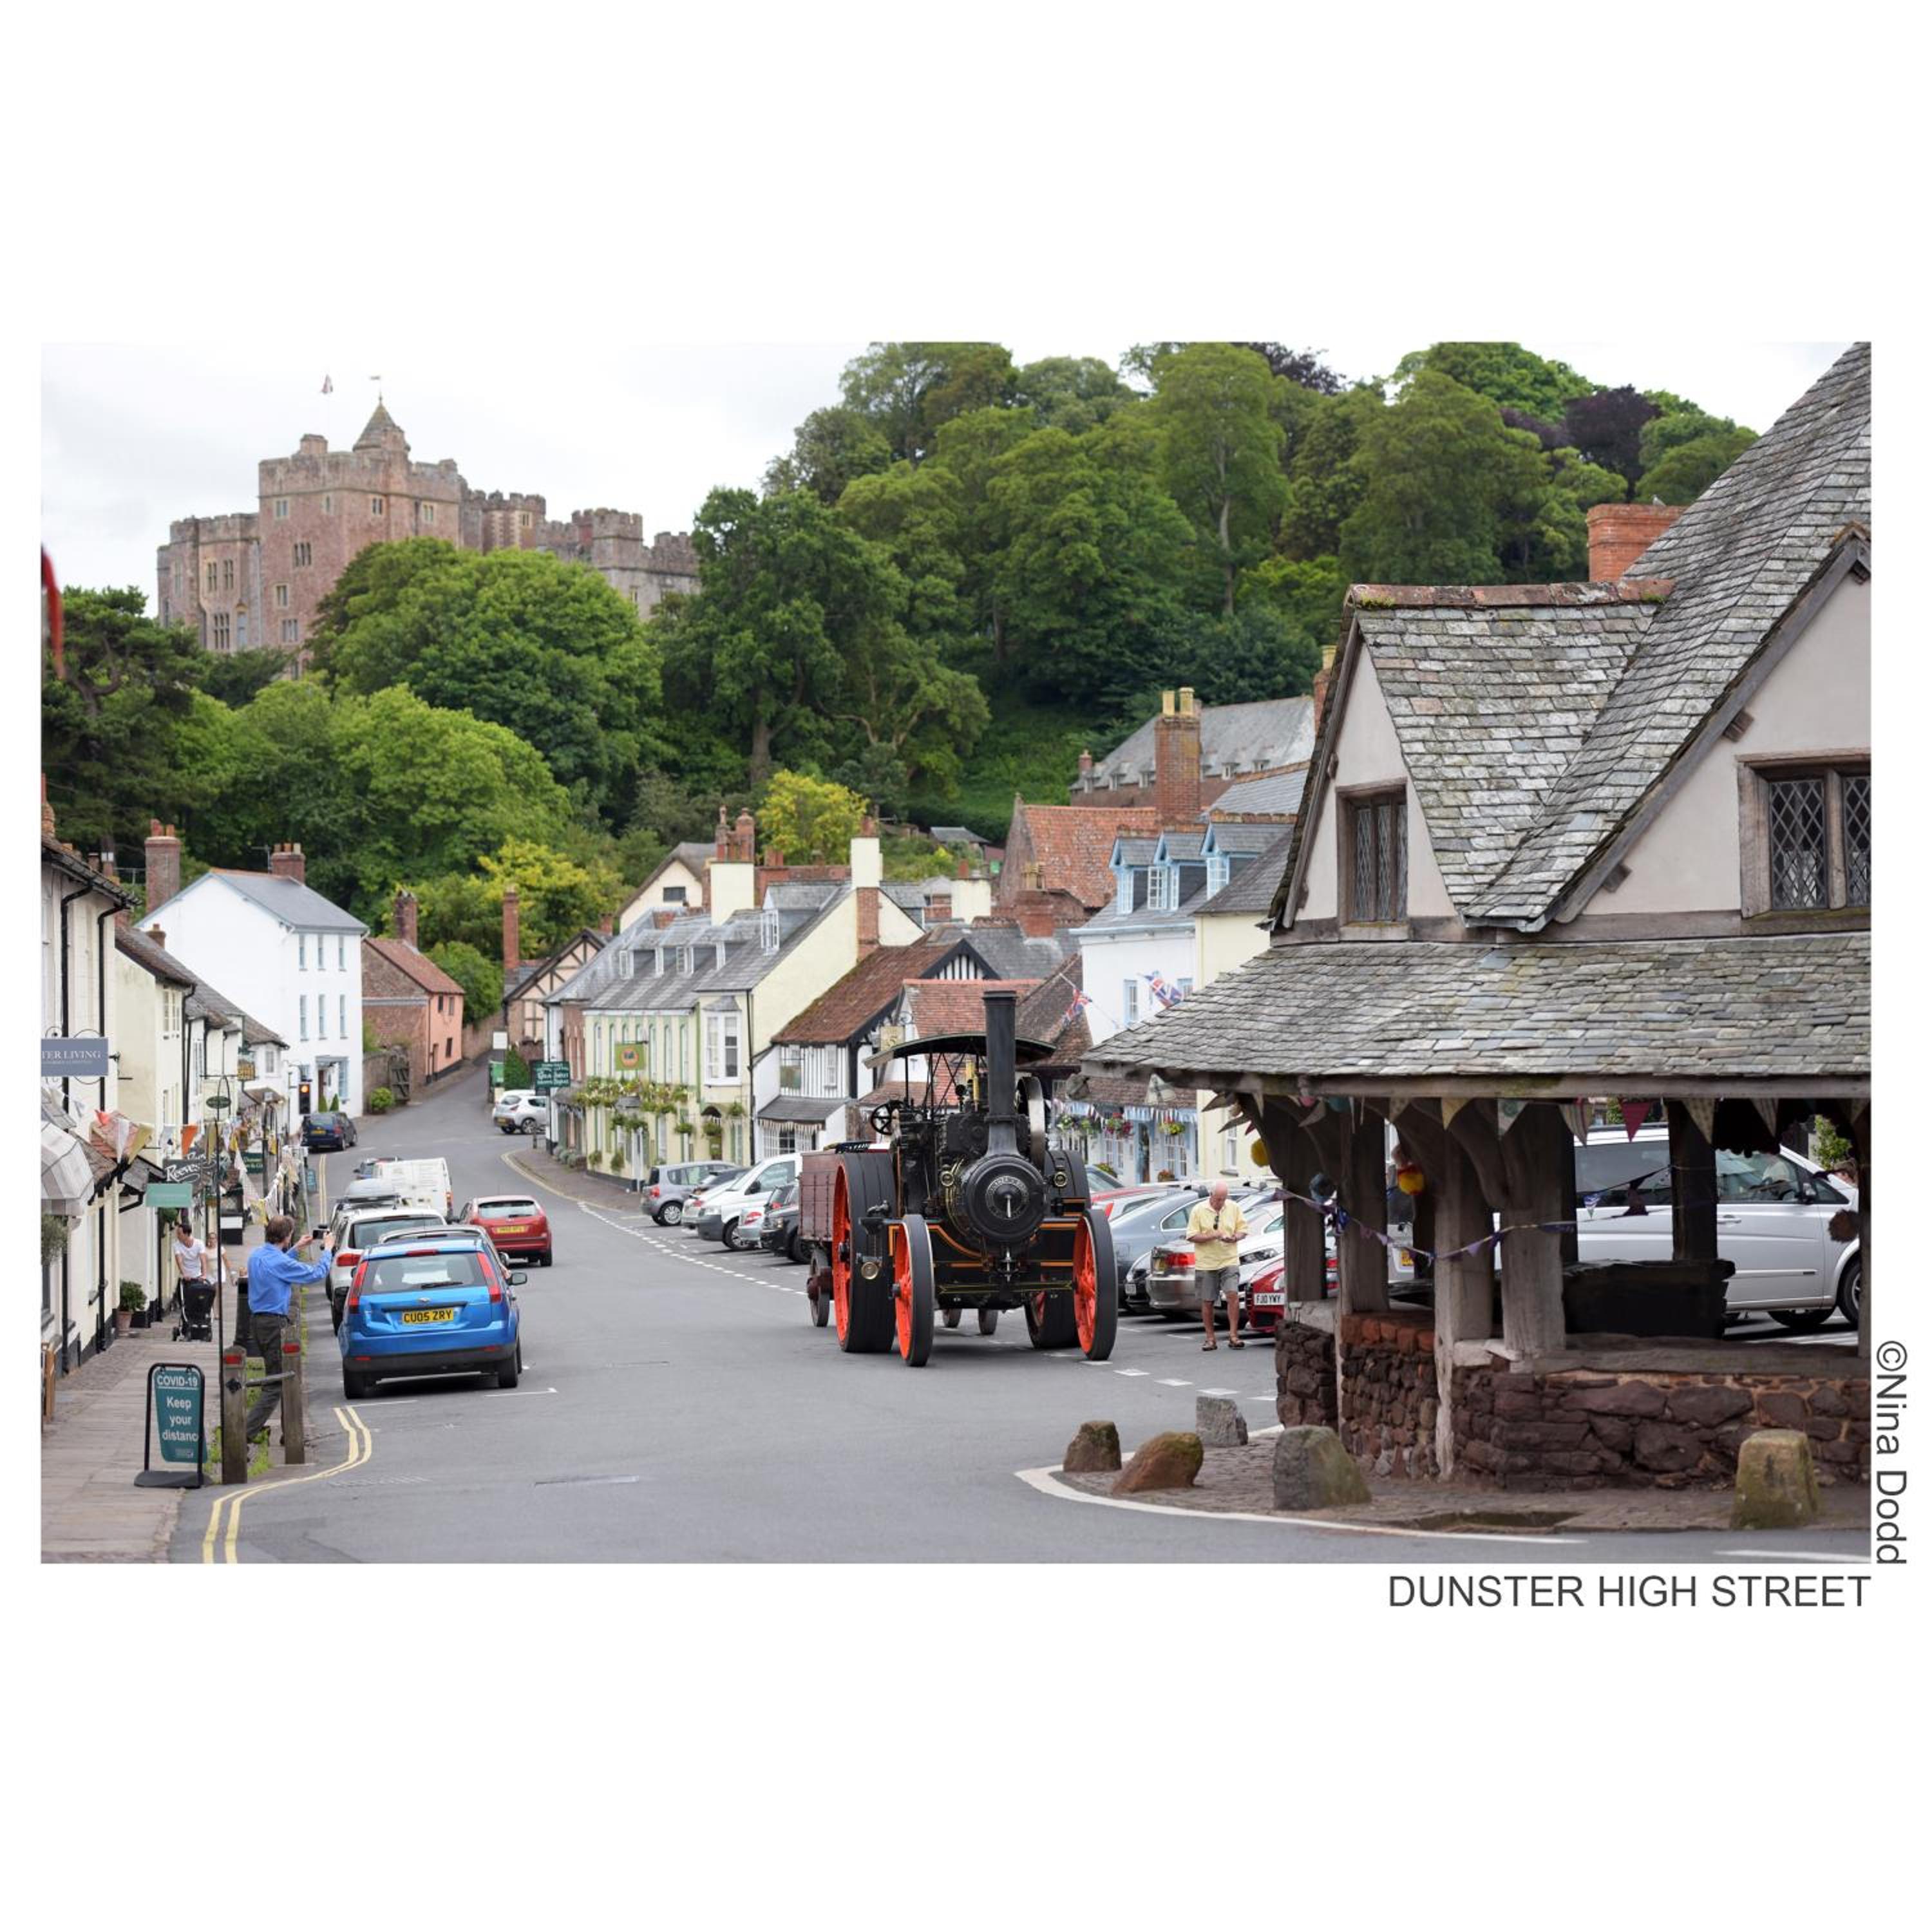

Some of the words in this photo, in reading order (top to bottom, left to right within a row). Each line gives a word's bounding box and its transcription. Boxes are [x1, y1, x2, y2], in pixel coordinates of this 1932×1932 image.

[64, 1050, 102, 1059] LIVING
[404, 1312, 430, 1323] CU05
[432, 1309, 452, 1321] ZRY
[156, 1375, 198, 1387] COVID-19
[166, 1396, 191, 1411] Keep
[169, 1416, 192, 1427] your
[162, 1429, 199, 1441] distanc
